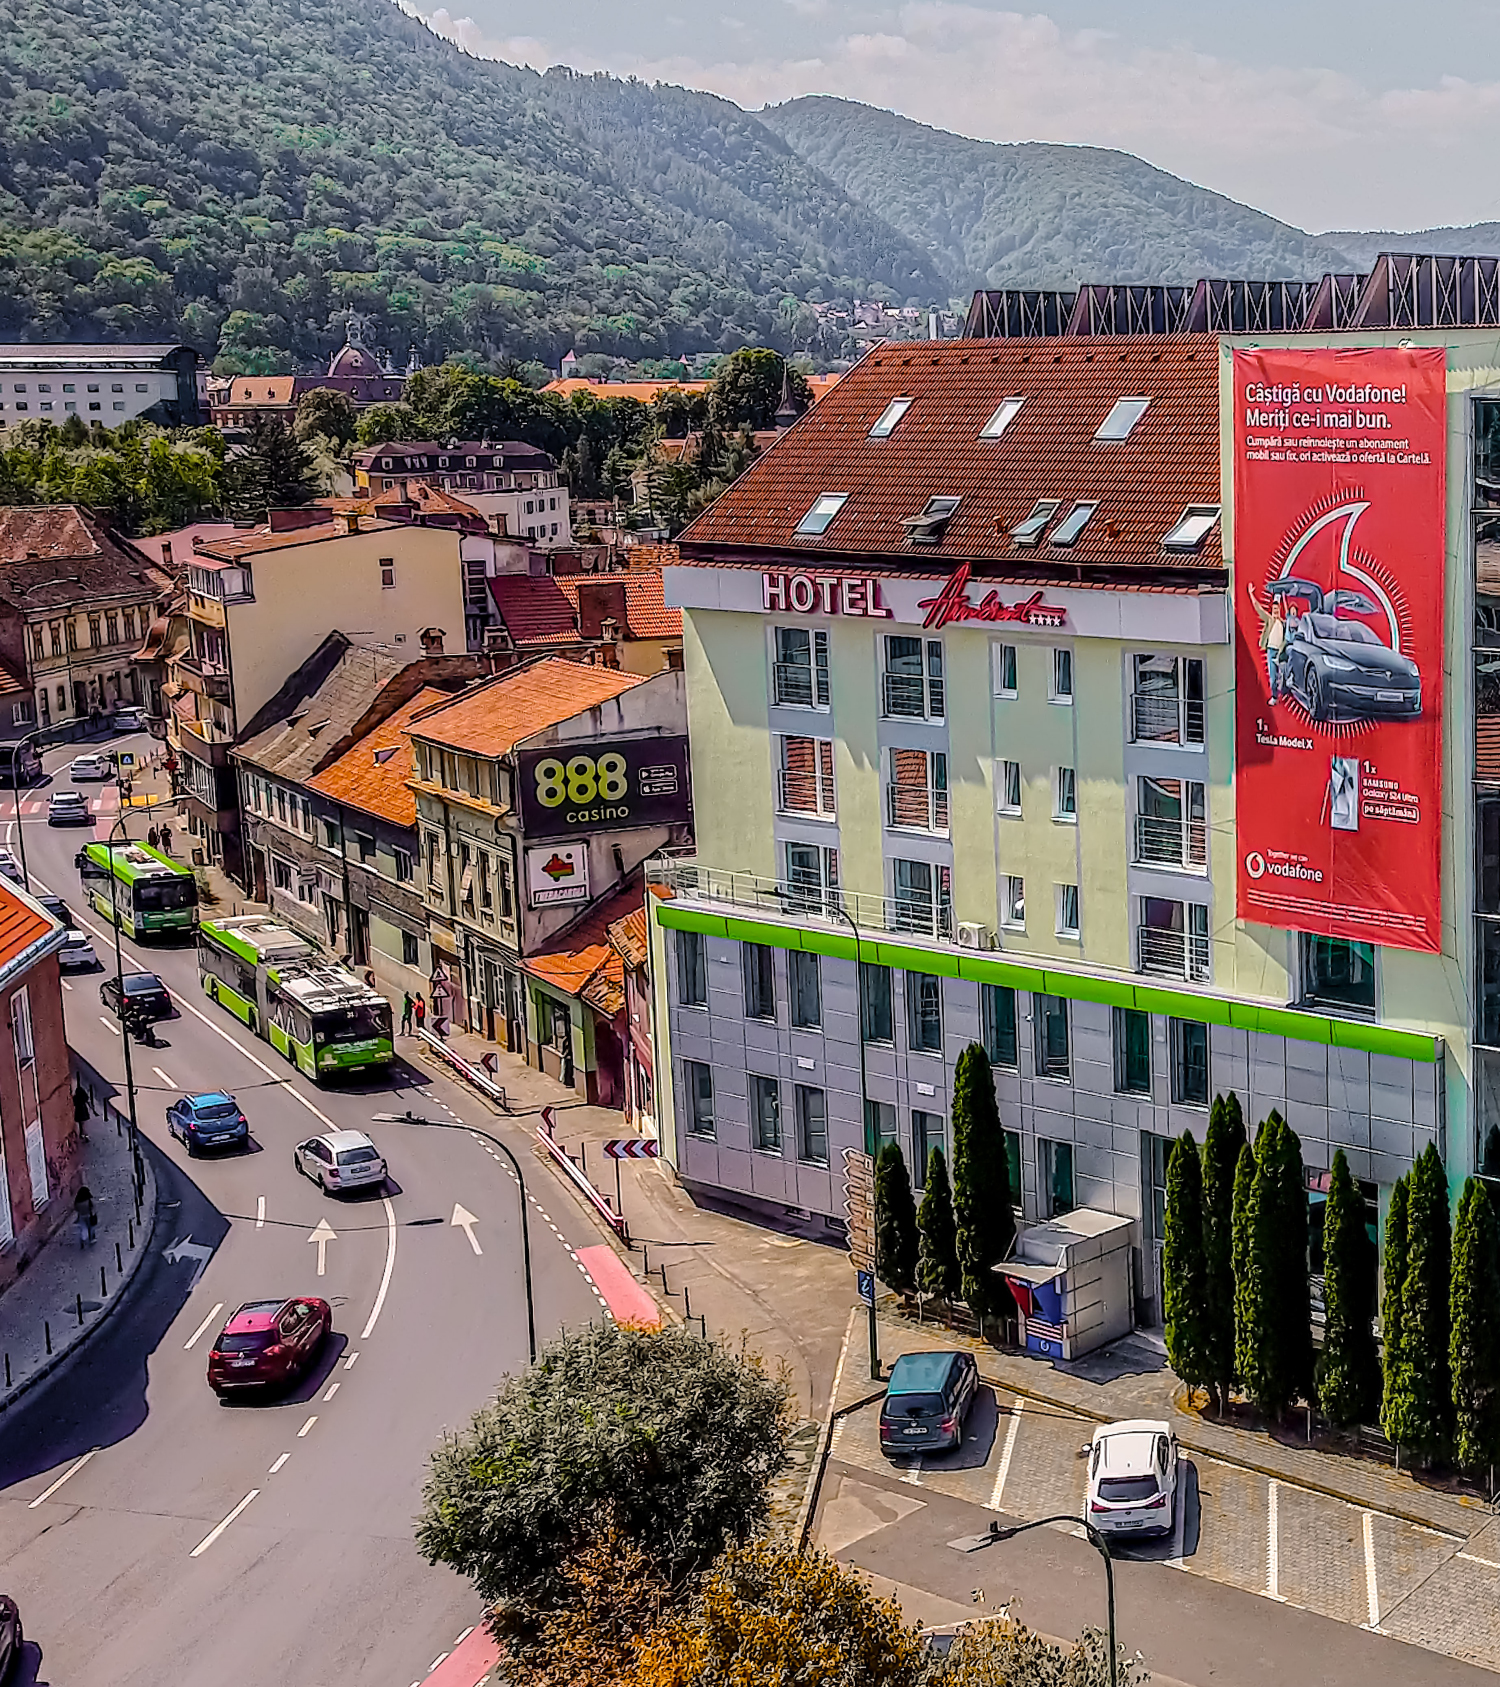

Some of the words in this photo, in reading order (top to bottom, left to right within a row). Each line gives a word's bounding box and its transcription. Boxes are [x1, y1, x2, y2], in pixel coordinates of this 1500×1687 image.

[1246, 382, 1300, 406] Câștigă
[1303, 387, 1322, 403] cu
[1325, 383, 1407, 403] Vodafone!
[1246, 408, 1290, 431] Meriți
[1293, 409, 1321, 428] ce-i
[1323, 409, 1353, 428] mai
[1355, 409, 1392, 428] bun.
[1283, 438, 1298, 447] sau
[1346, 439, 1357, 448] un
[1359, 438, 1409, 450] abonament
[1246, 450, 1270, 461] mobil
[1271, 452, 1285, 461] sau
[1352, 454, 1357, 462] o
[1387, 452, 1395, 463] la
[761, 572, 889, 618] HOTEL
[1256, 733, 1279, 746] Tesla
[1279, 735, 1305, 749] Model
[1306, 739, 1313, 750] X
[1363, 760, 1377, 774] 1x
[534, 752, 628, 808] 888
[566, 805, 629, 823] casino
[1267, 862, 1323, 882] vodafone
